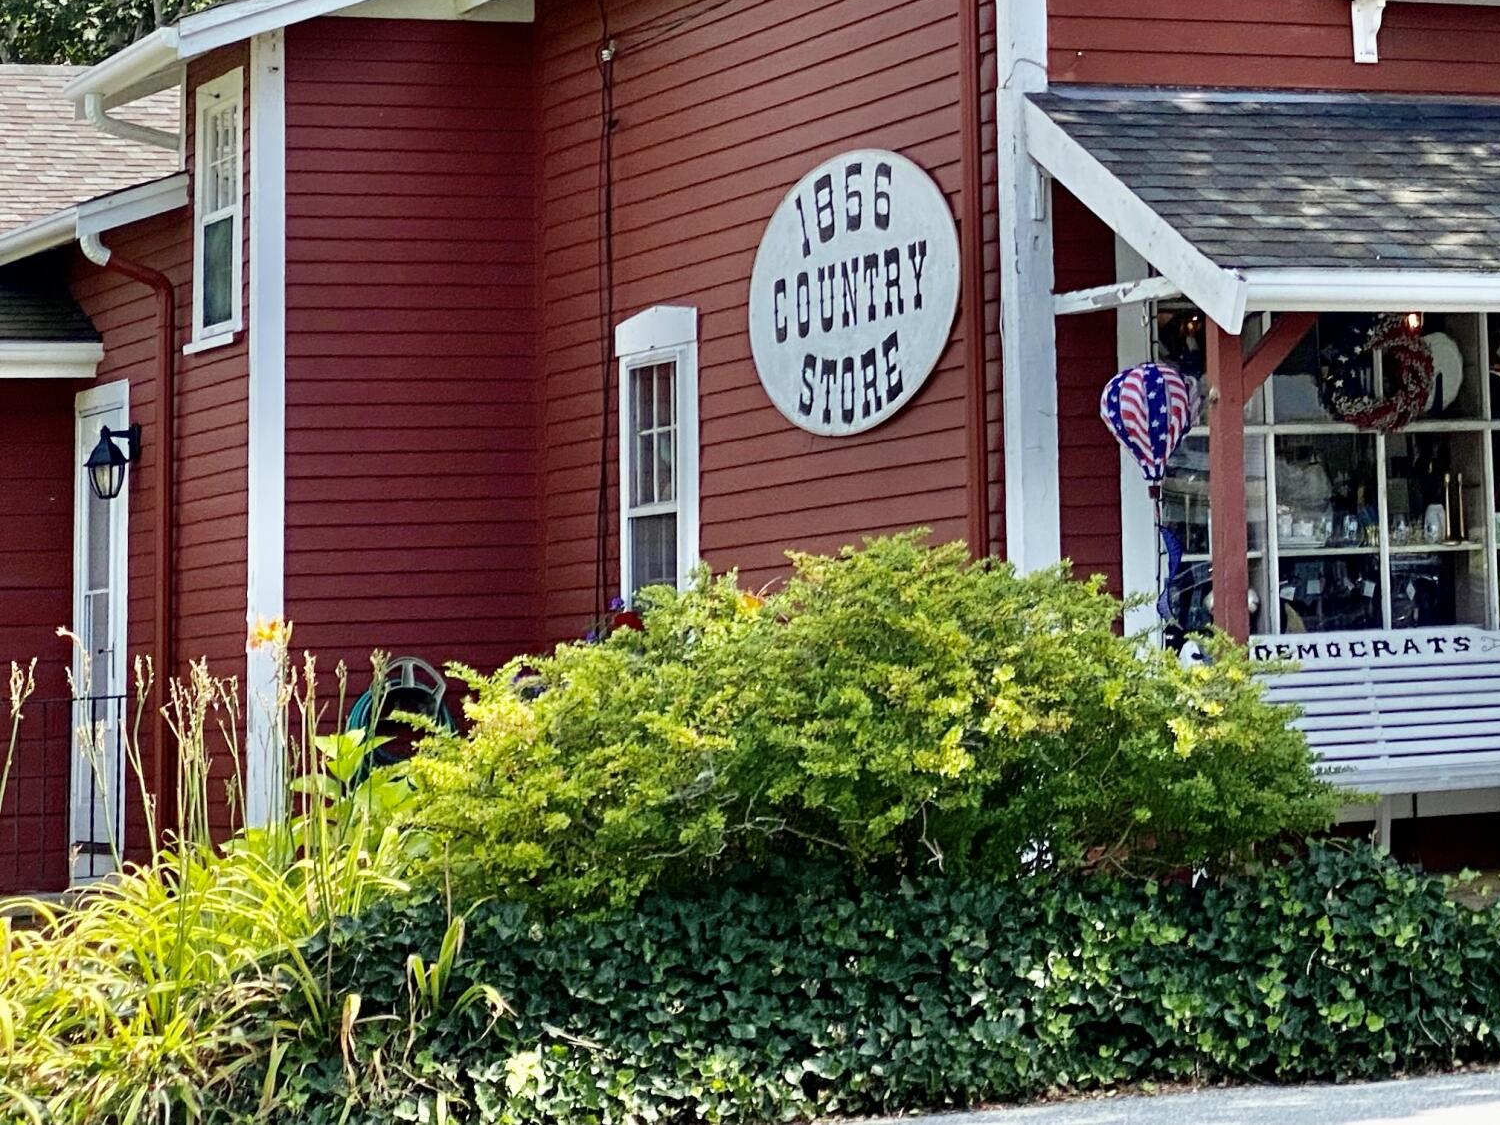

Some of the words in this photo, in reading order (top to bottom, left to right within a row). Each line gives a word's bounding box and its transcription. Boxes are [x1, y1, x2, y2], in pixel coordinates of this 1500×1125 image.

[794, 162, 892, 259] 1856
[773, 239, 928, 344] COUNTRY
[797, 330, 904, 425] STORE
[1254, 636, 1472, 662] DEMOCRATS
